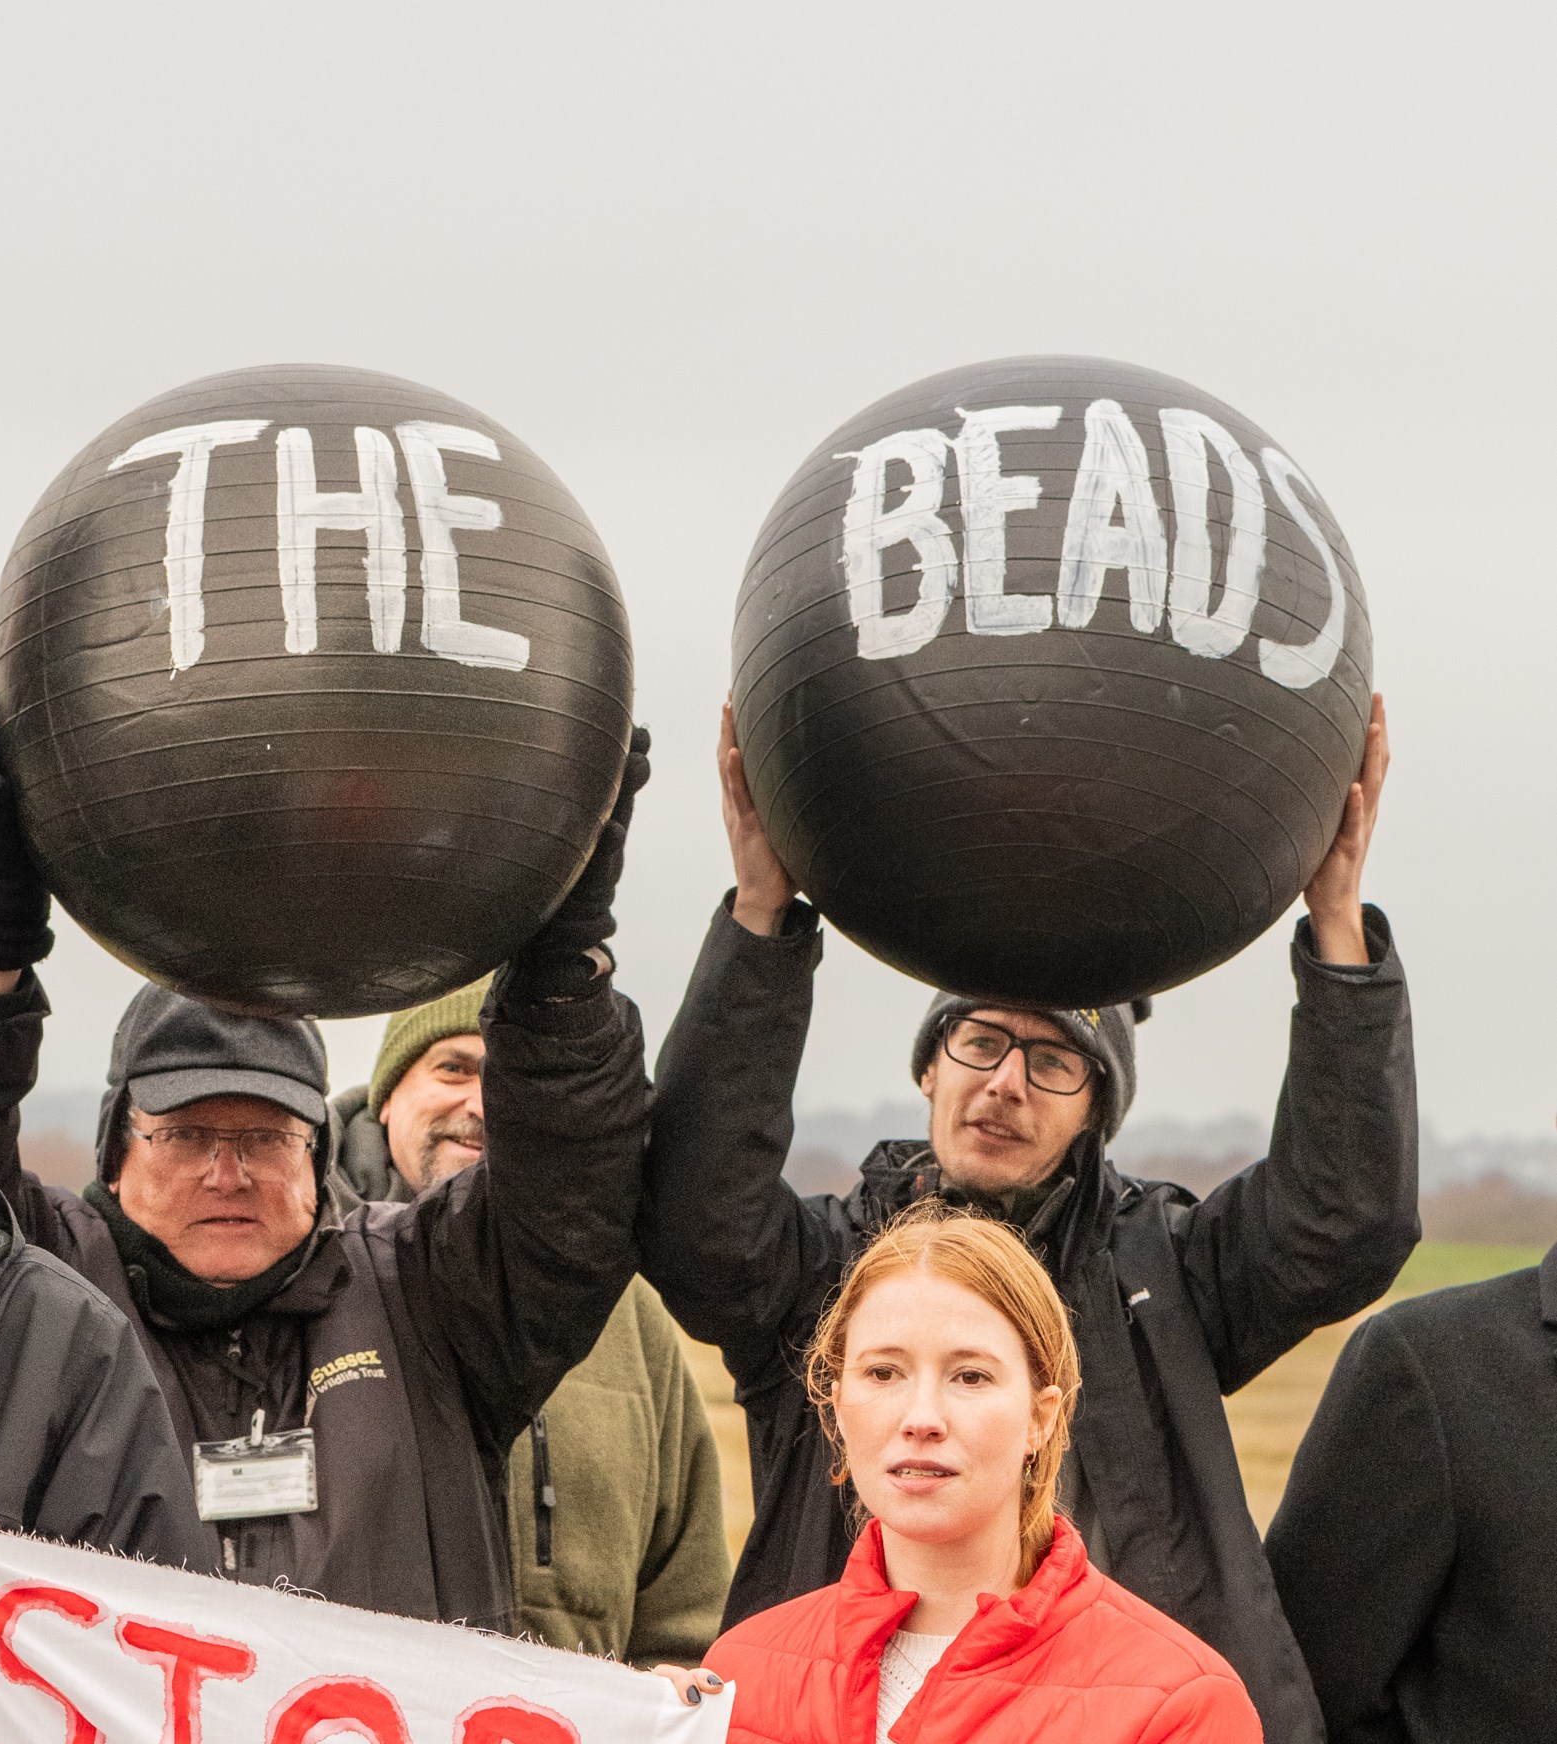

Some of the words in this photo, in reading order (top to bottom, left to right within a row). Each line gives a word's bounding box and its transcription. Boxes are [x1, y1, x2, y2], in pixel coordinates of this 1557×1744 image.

[107, 419, 531, 680] THE
[833, 398, 1346, 689] BEADS
[310, 1349, 382, 1387] Sussex
